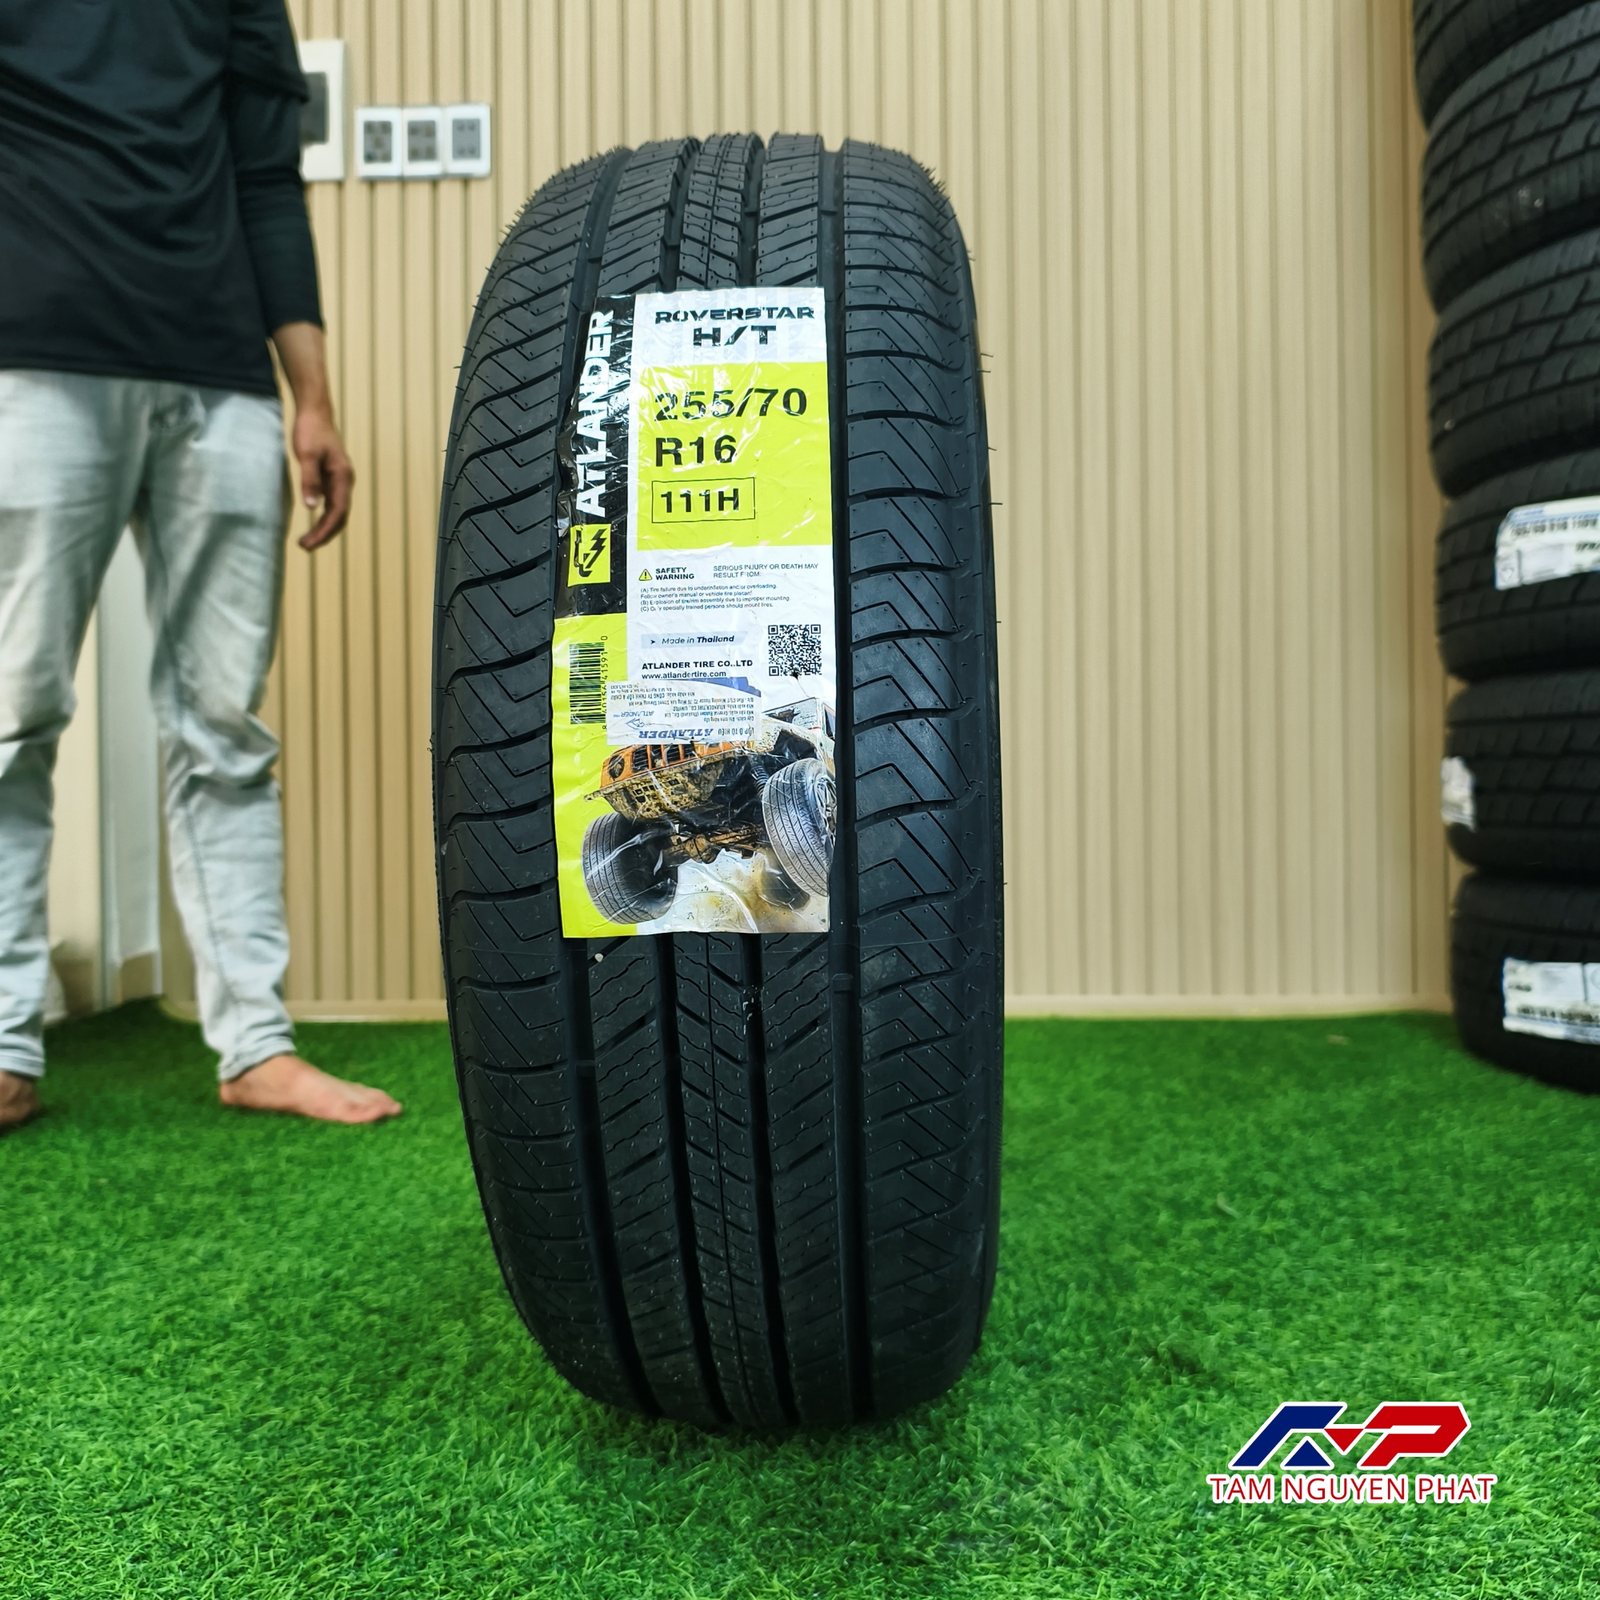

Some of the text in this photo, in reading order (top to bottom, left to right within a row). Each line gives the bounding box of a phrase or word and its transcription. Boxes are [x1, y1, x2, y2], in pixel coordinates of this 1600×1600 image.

[654, 306, 815, 324] ROVERSTAR
[692, 325, 777, 347] H/T
[576, 310, 614, 518] ATLANDER
[654, 388, 807, 421] 255/70
[655, 435, 737, 467] R16
[660, 488, 740, 513] 111H
[697, 635, 735, 643] Thailand
[642, 661, 690, 670] ATLANDER
[642, 670, 727, 679] www.atlandertire.com
[639, 729, 714, 739] ATLANDER
